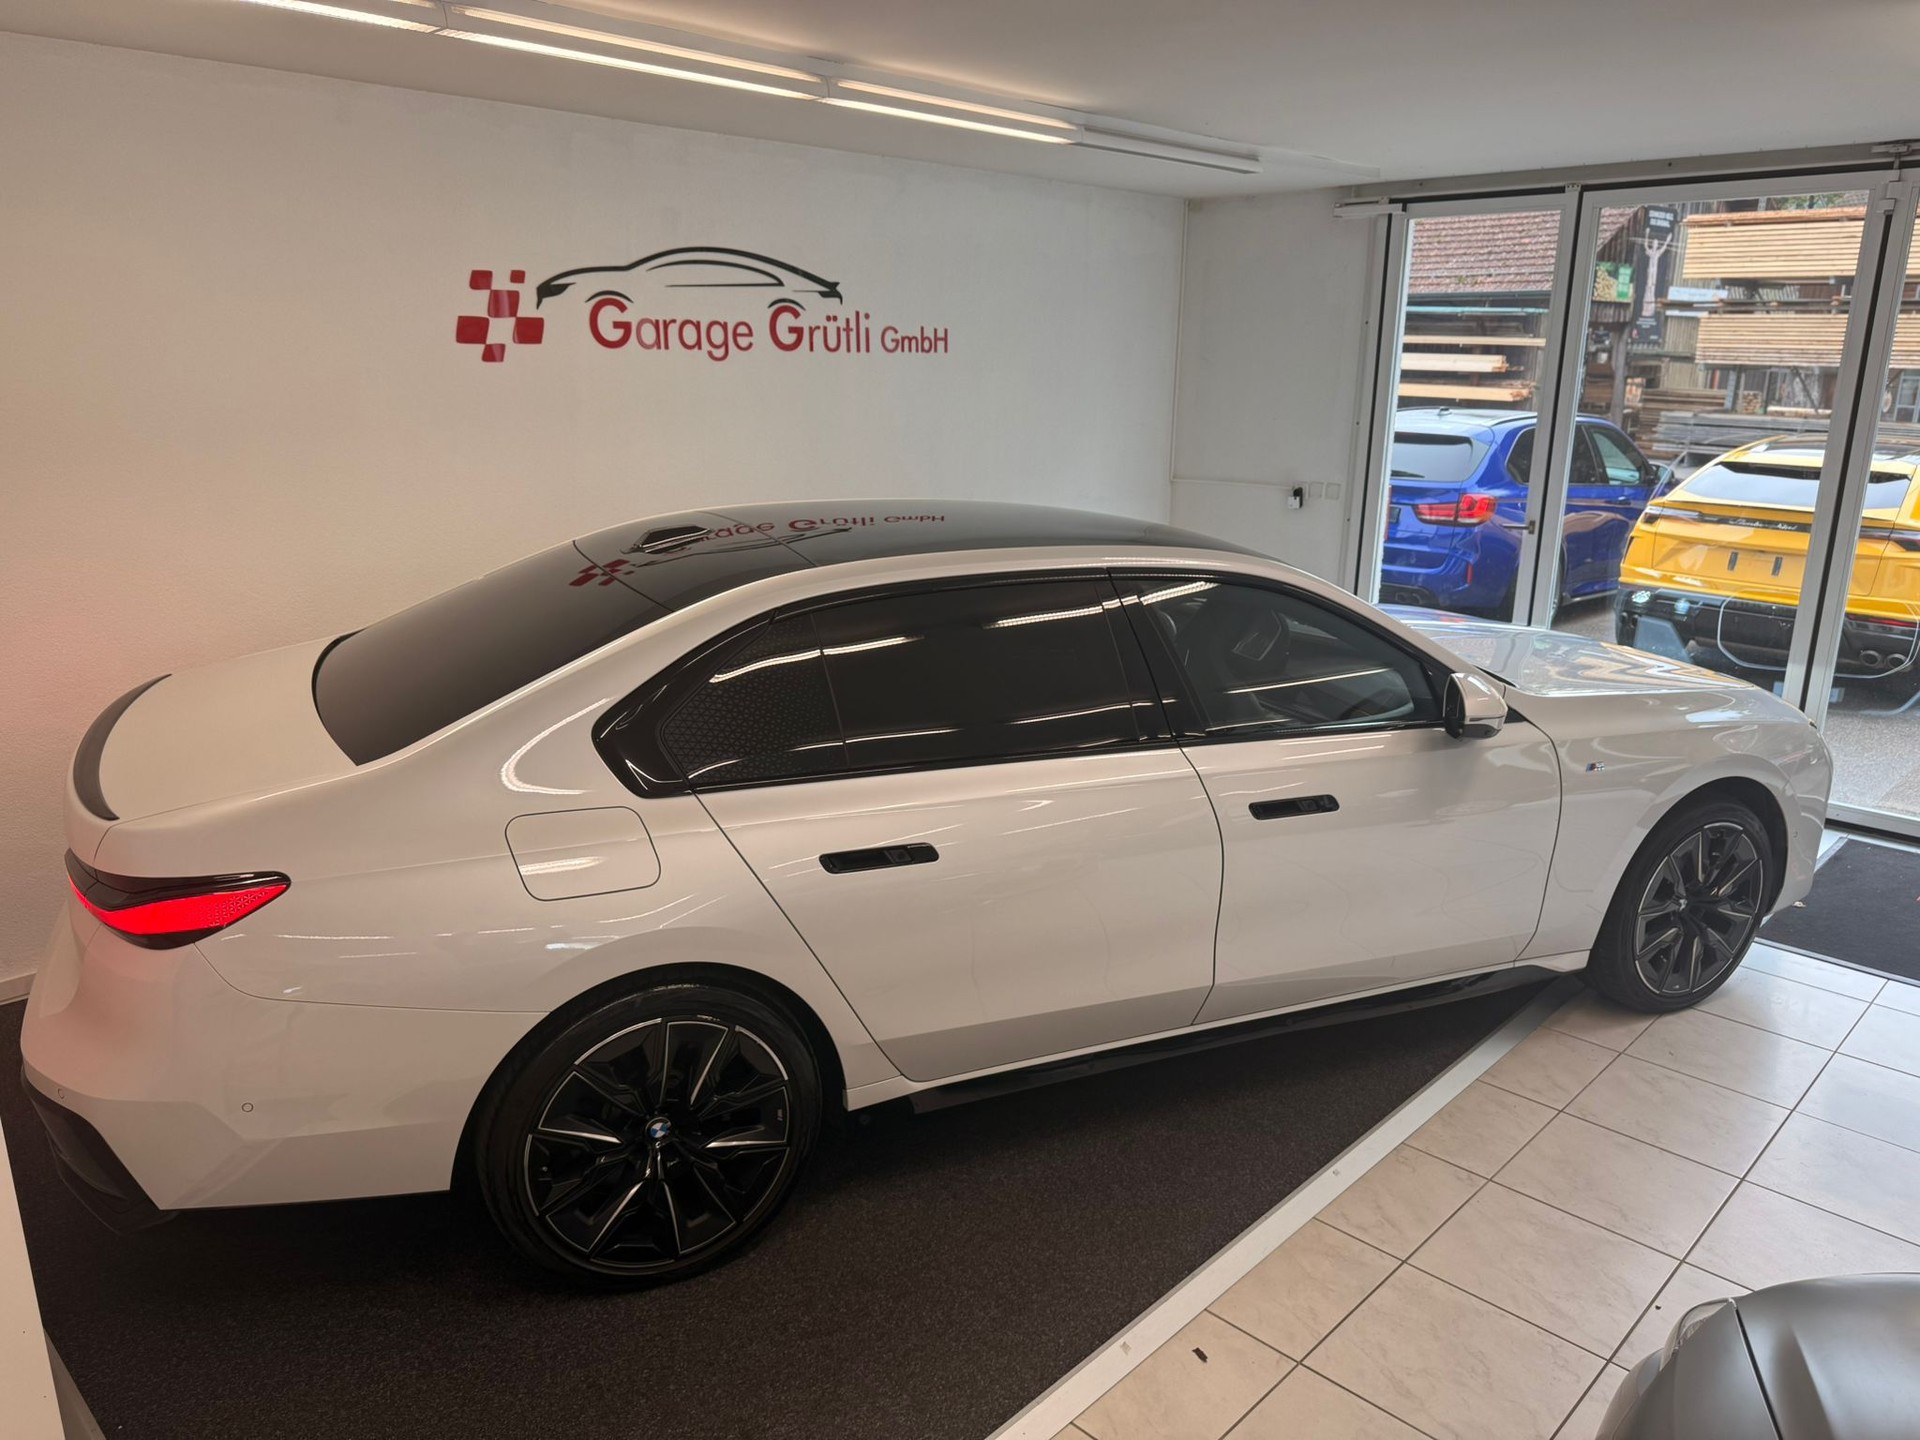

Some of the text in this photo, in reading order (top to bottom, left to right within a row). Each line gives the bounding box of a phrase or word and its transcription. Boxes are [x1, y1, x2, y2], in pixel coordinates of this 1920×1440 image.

[589, 297, 949, 362] Garage Grütli GmbH
